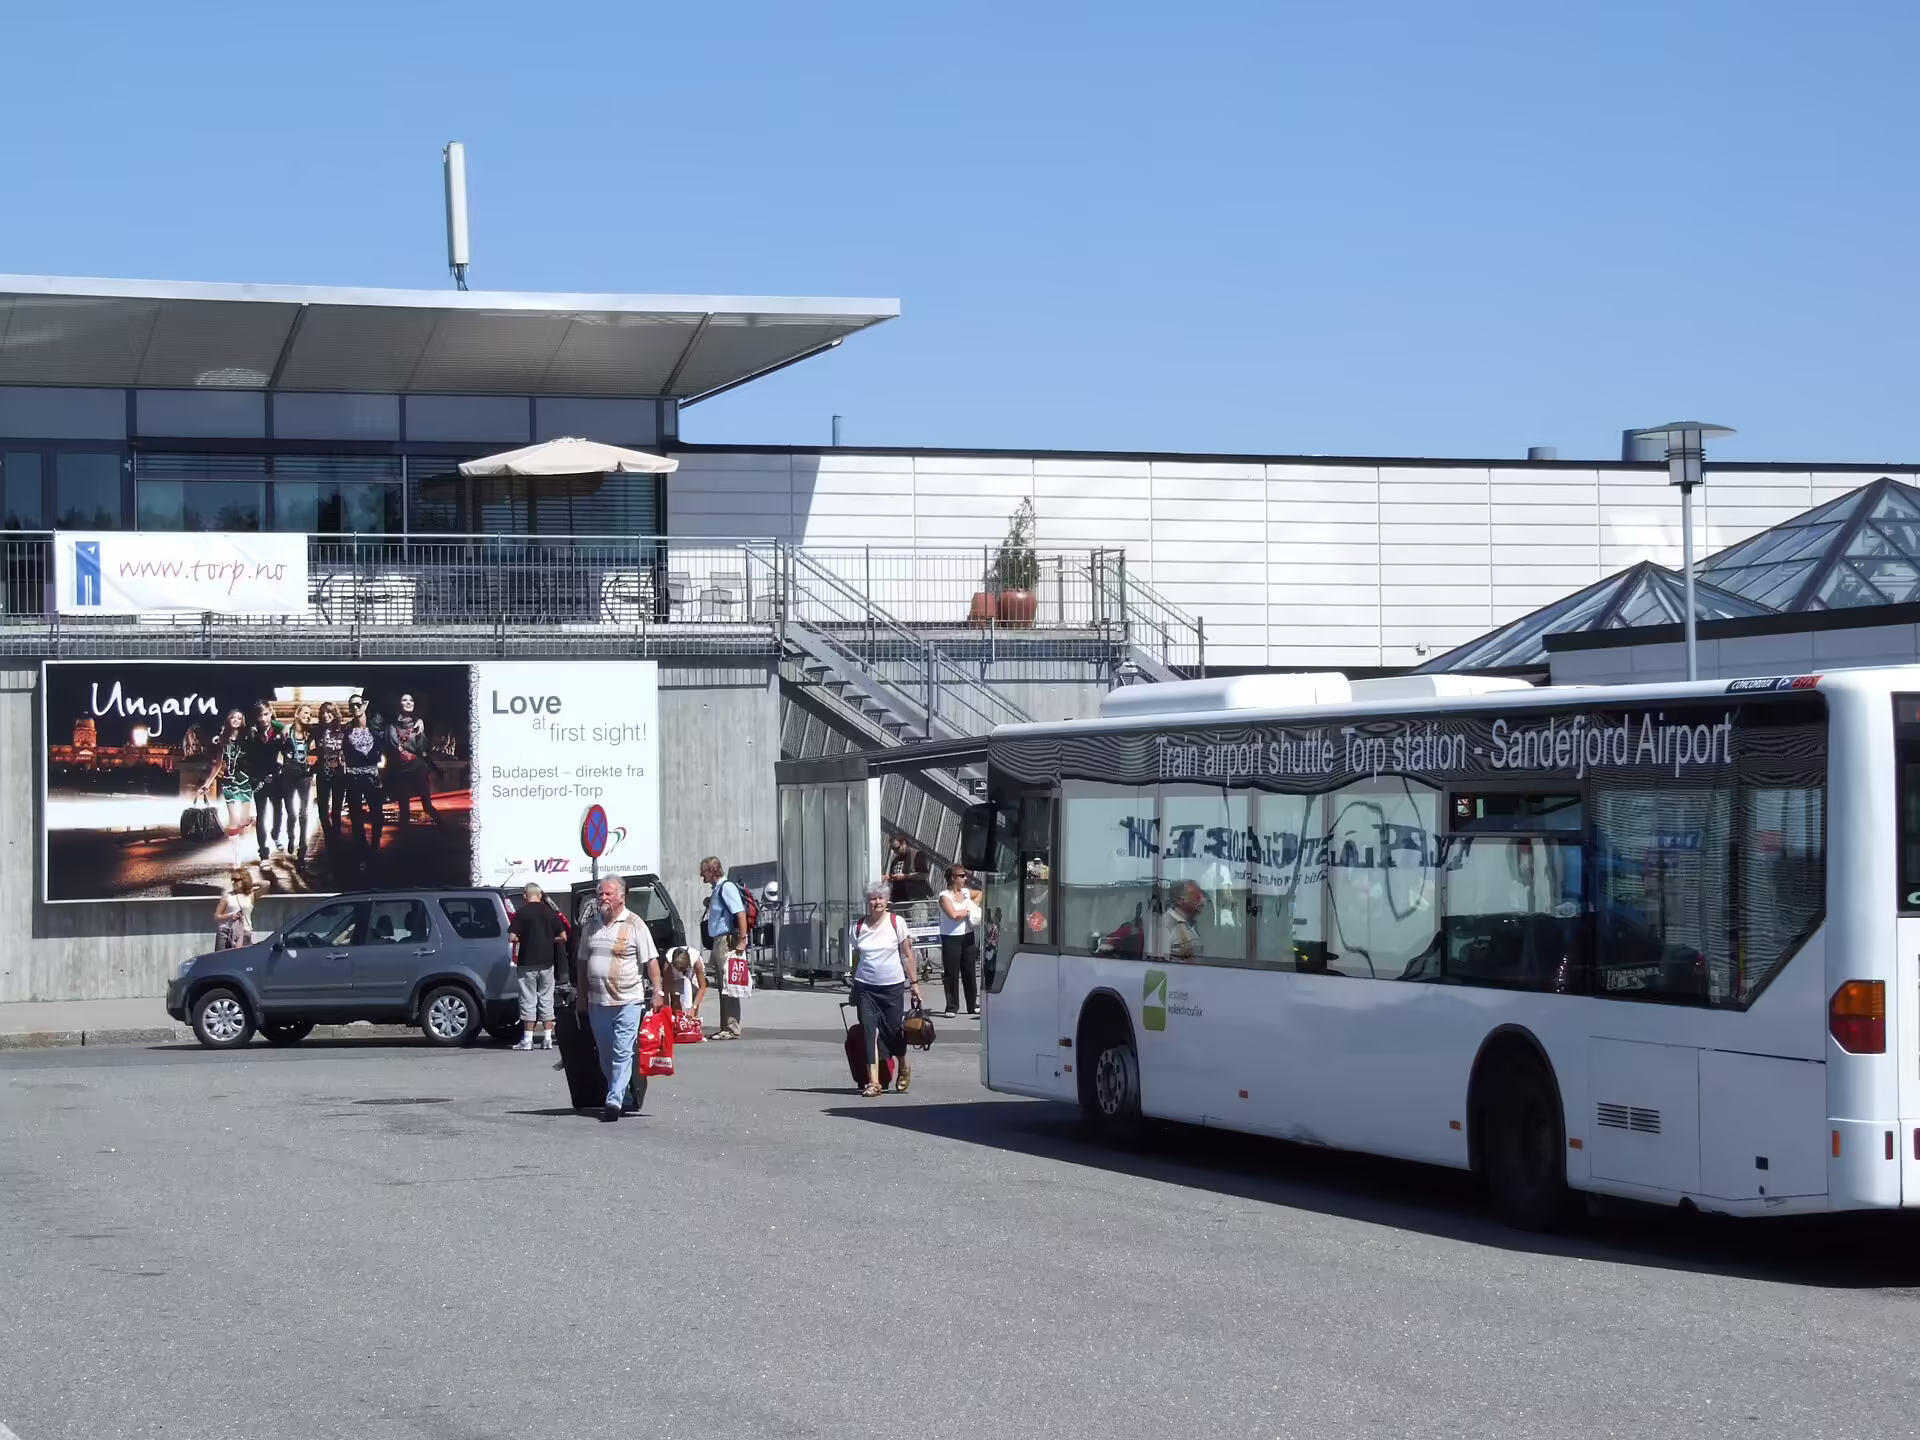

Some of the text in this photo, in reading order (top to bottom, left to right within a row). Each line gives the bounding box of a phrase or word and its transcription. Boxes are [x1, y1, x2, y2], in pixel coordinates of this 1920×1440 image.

[119, 560, 288, 596] www.torp.no
[92, 681, 219, 738] Ungarn
[492, 690, 562, 715] Love
[532, 715, 546, 730] at
[550, 722, 648, 746] first sight!
[1156, 736, 1198, 777] Train
[1204, 734, 1263, 786] airport
[1269, 729, 1334, 775] shuttle
[1341, 726, 1386, 783] Torp
[1393, 722, 1466, 771] station
[1490, 714, 1629, 779] Sandefjord
[1635, 712, 1732, 778] Airport
[492, 765, 559, 781] Budapest
[576, 765, 622, 778] direkte
[627, 765, 644, 777] fra
[492, 784, 603, 800] Sandefjord-Torp
[579, 864, 648, 875] ungoturisme.com
